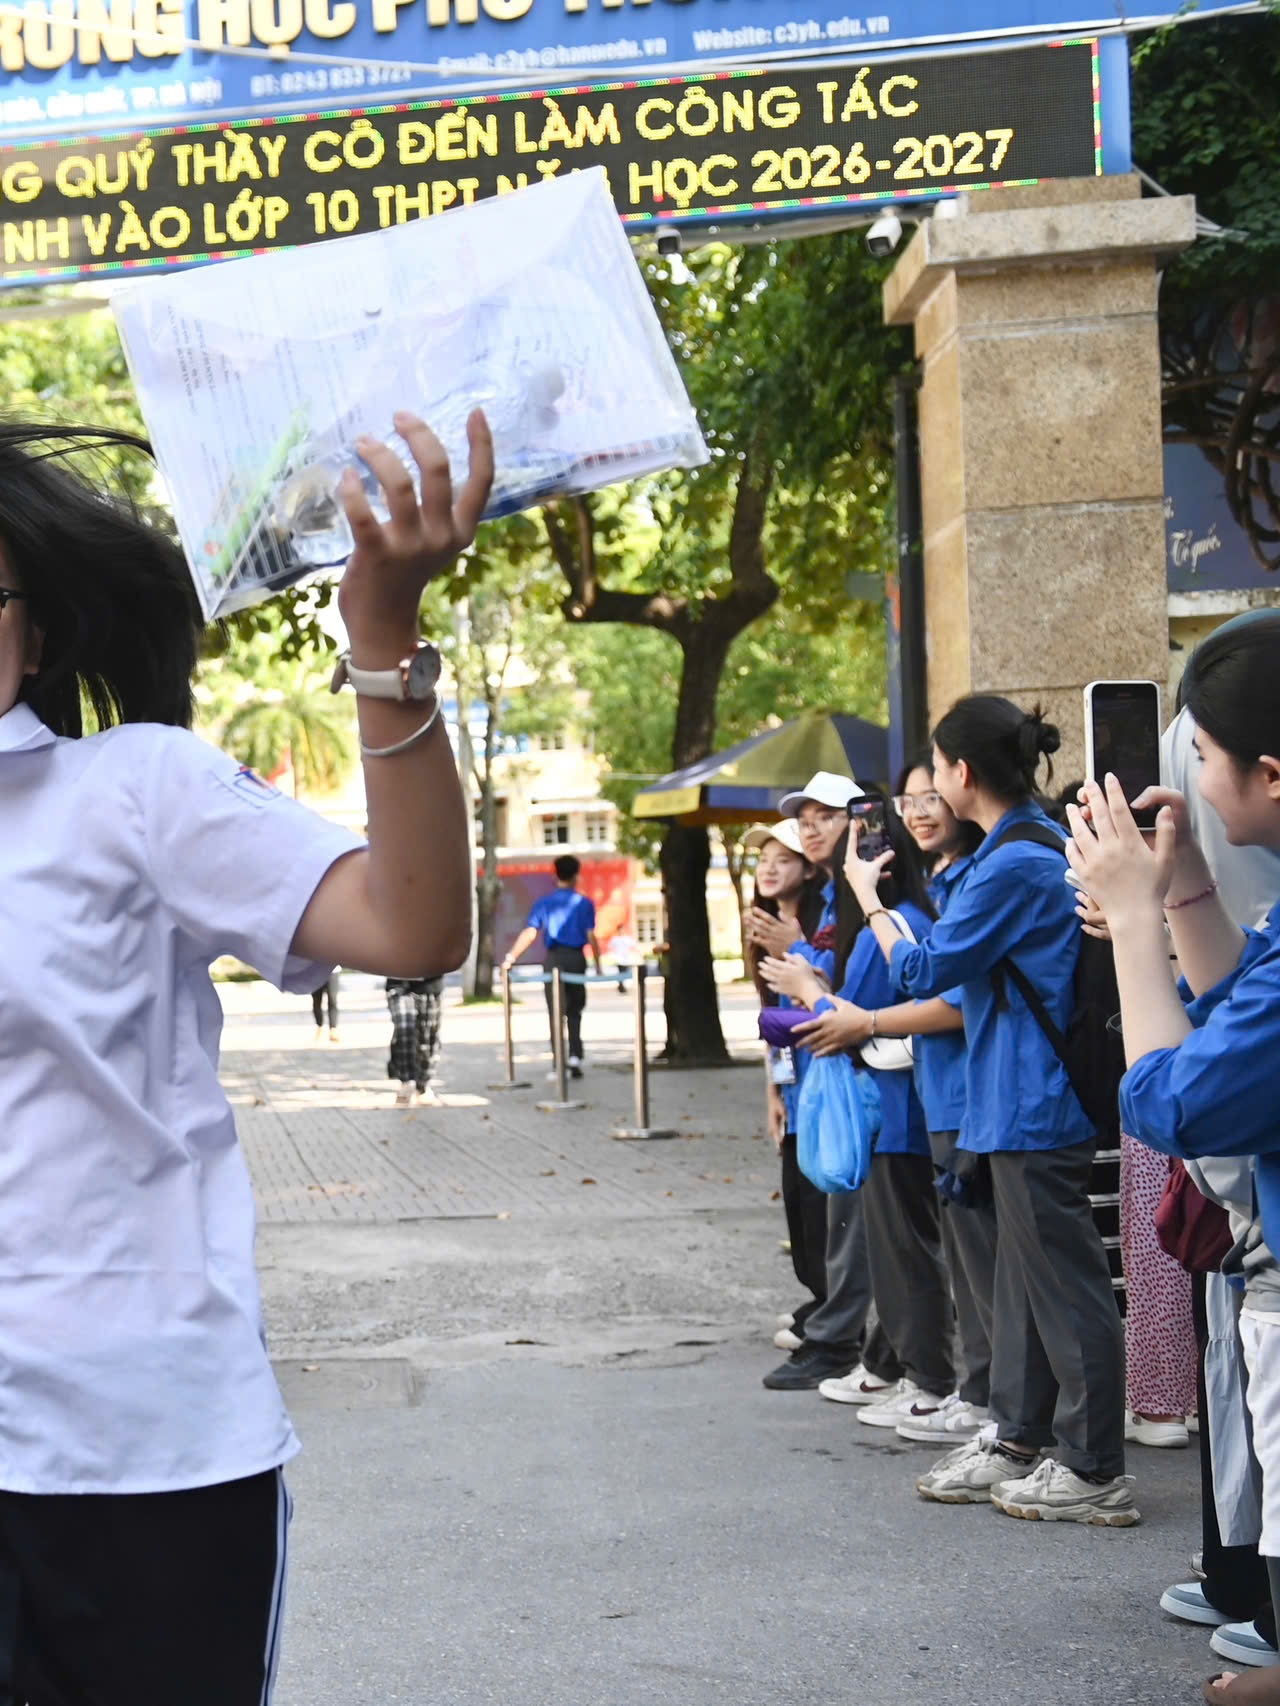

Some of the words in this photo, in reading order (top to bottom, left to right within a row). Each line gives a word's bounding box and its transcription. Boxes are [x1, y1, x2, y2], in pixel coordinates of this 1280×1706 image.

[55, 137, 155, 198] QUÝ
[303, 118, 385, 173] CÔ
[396, 106, 498, 165] ĐẾN
[514, 96, 621, 154] LÀM
[635, 86, 801, 141] CÔNG
[817, 67, 919, 123] TÁC
[81, 201, 191, 256] VÀO
[203, 188, 289, 244] LỚP
[307, 189, 360, 235] 10
[372, 177, 480, 228] THPT
[628, 154, 739, 208] HỌC
[751, 128, 1014, 193] 2026-2027
